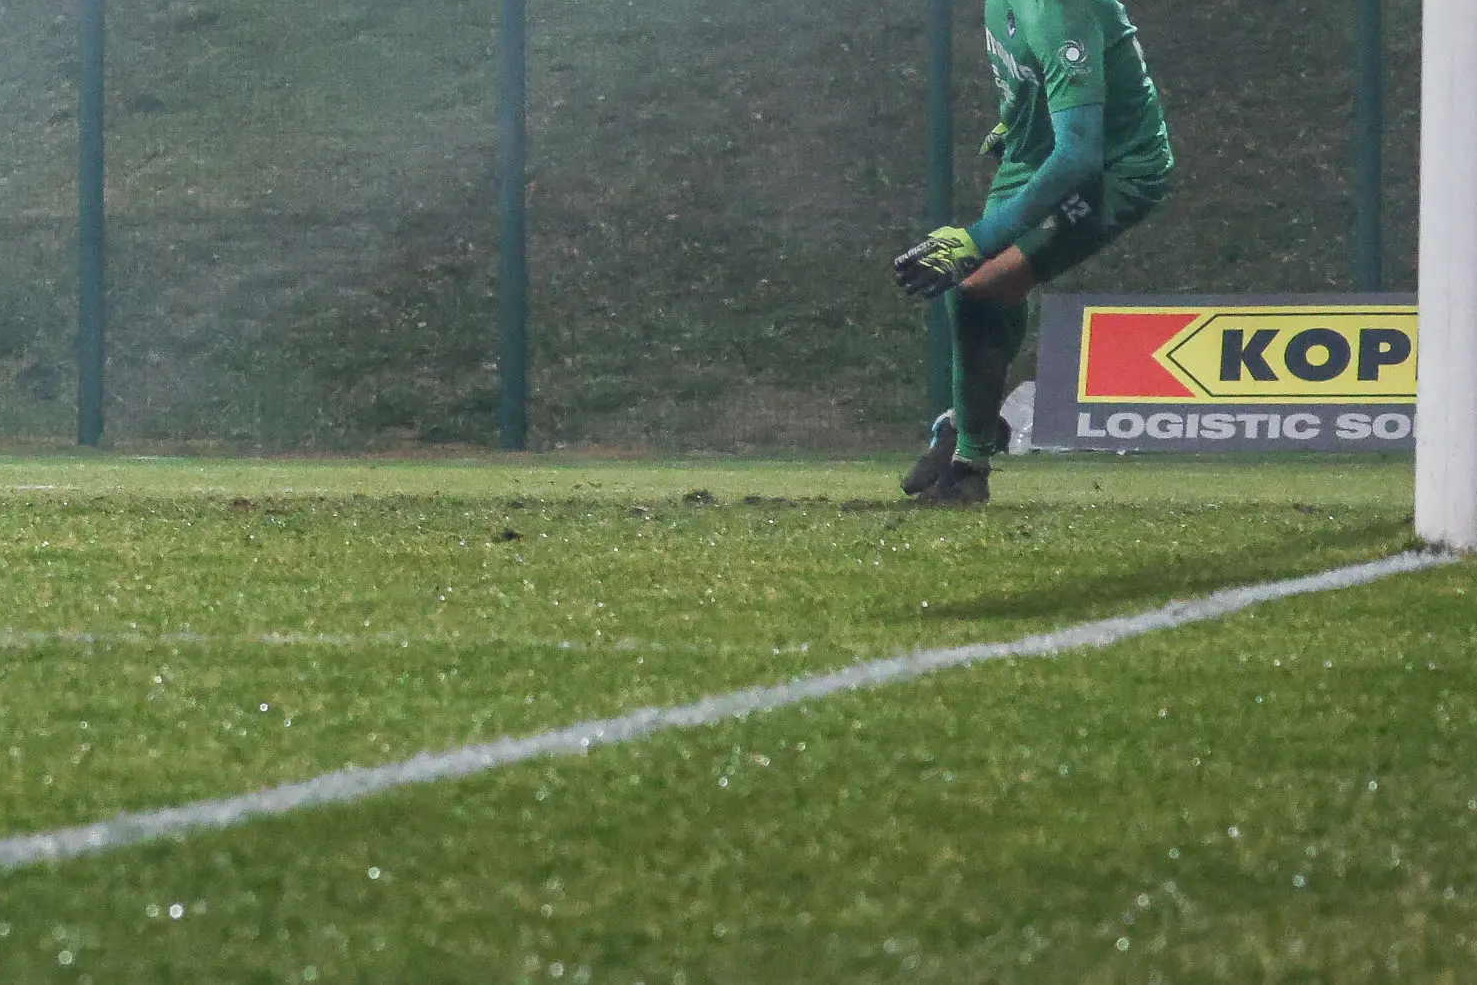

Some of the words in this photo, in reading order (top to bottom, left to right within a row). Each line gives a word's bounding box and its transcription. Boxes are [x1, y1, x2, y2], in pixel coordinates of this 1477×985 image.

[1219, 327, 1419, 382] KOP
[1076, 412, 1321, 440] LOGISTIC
[1335, 412, 1417, 440] SO
